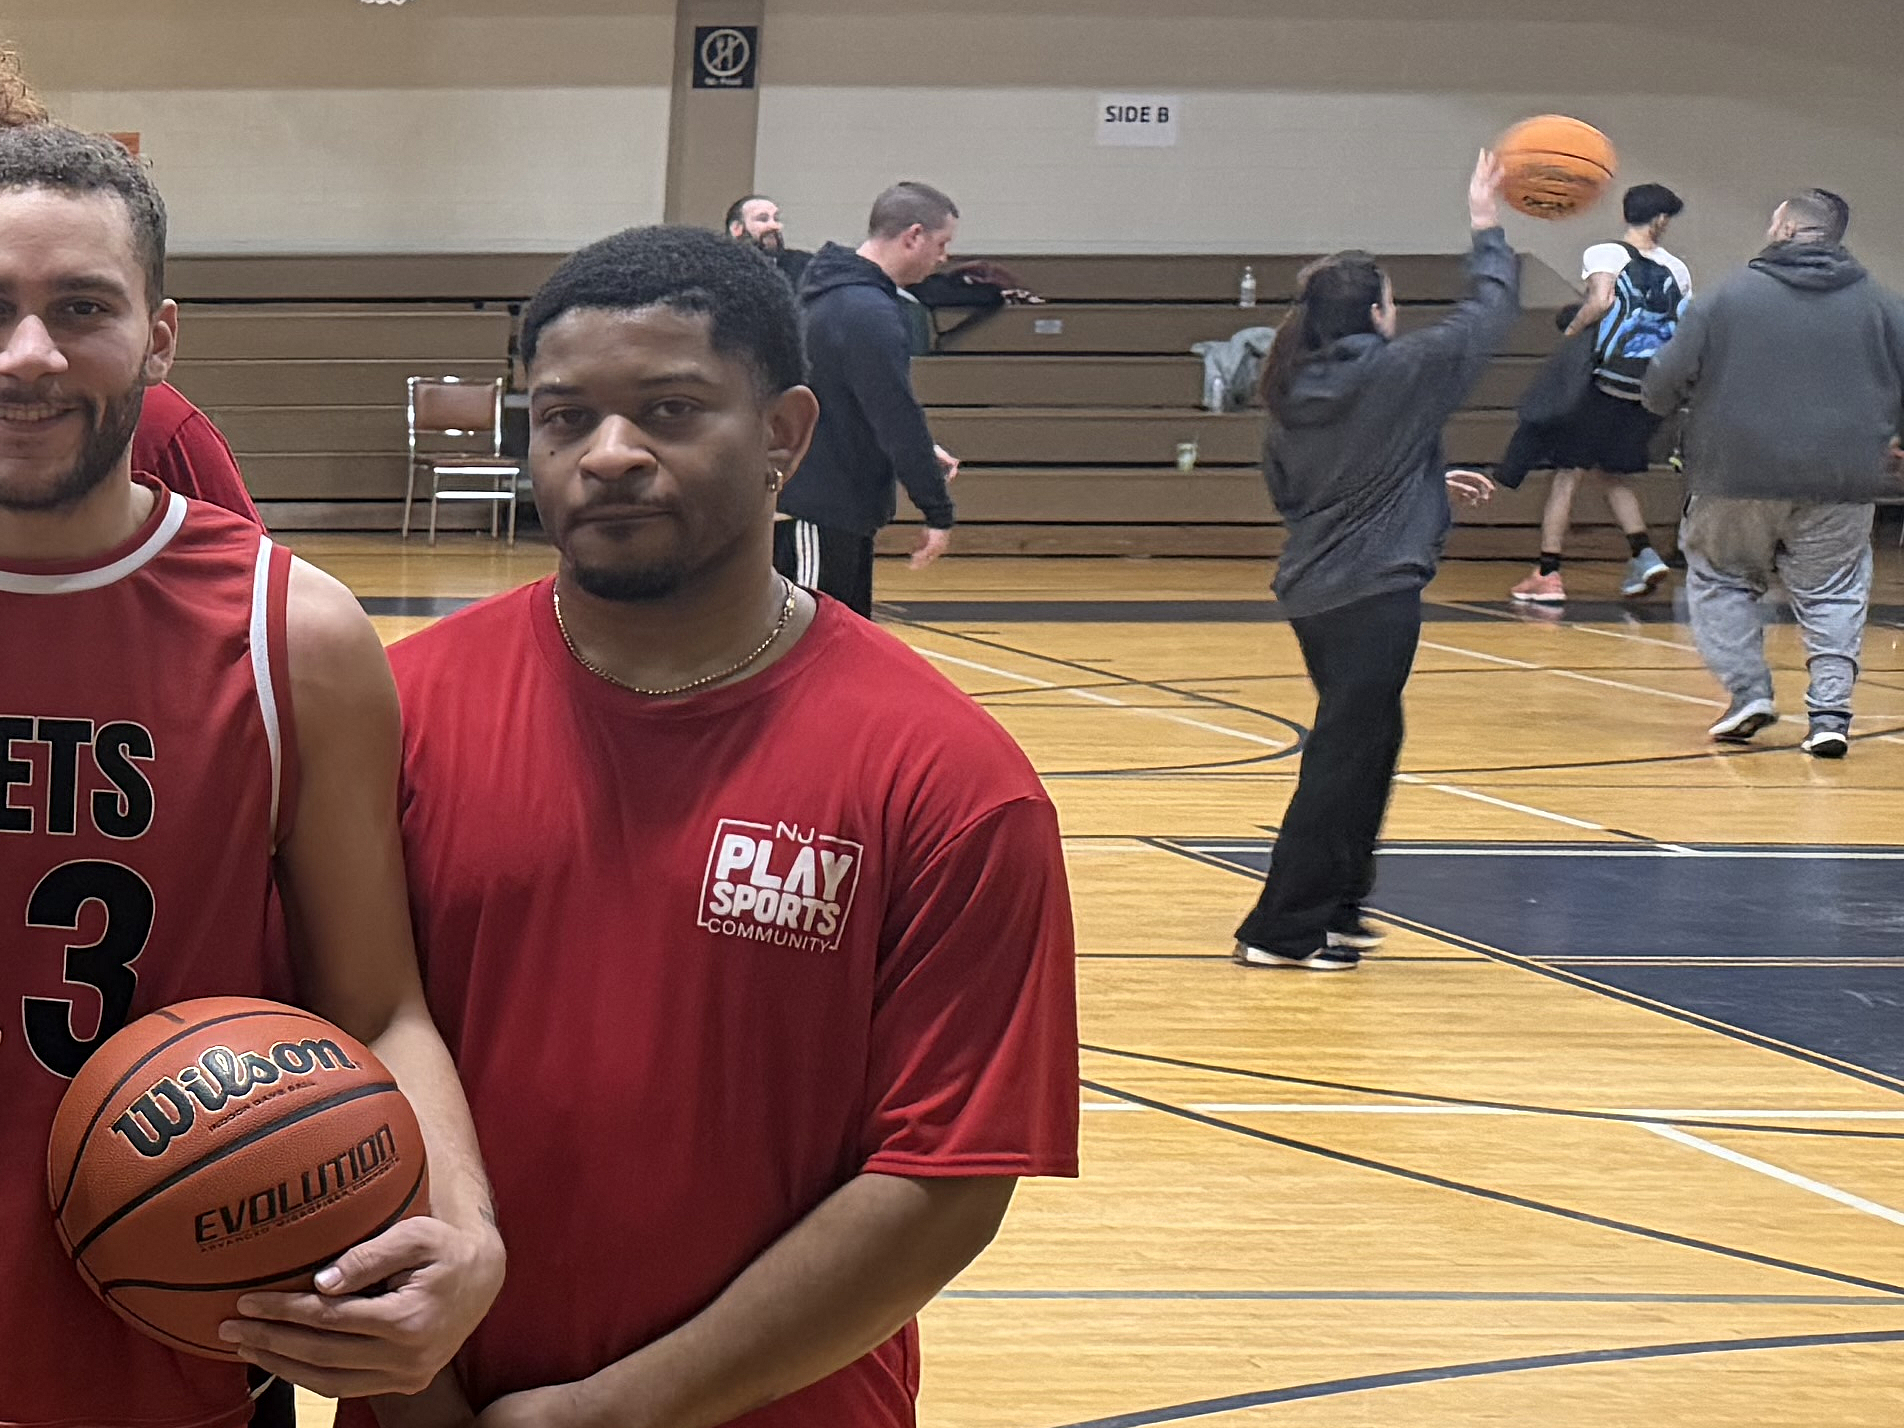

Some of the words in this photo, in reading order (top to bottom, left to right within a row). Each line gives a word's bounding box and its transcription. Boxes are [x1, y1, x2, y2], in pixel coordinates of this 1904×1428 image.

[1105, 105, 1151, 123] SIDE
[1158, 107, 1169, 123] B
[776, 821, 815, 844] NJ
[715, 833, 853, 901] PLAY
[707, 918, 830, 954] COMMUNITY
[709, 881, 841, 936] SPORTS
[109, 1038, 361, 1157] Wilson
[194, 1123, 397, 1243] EVOLUTION
